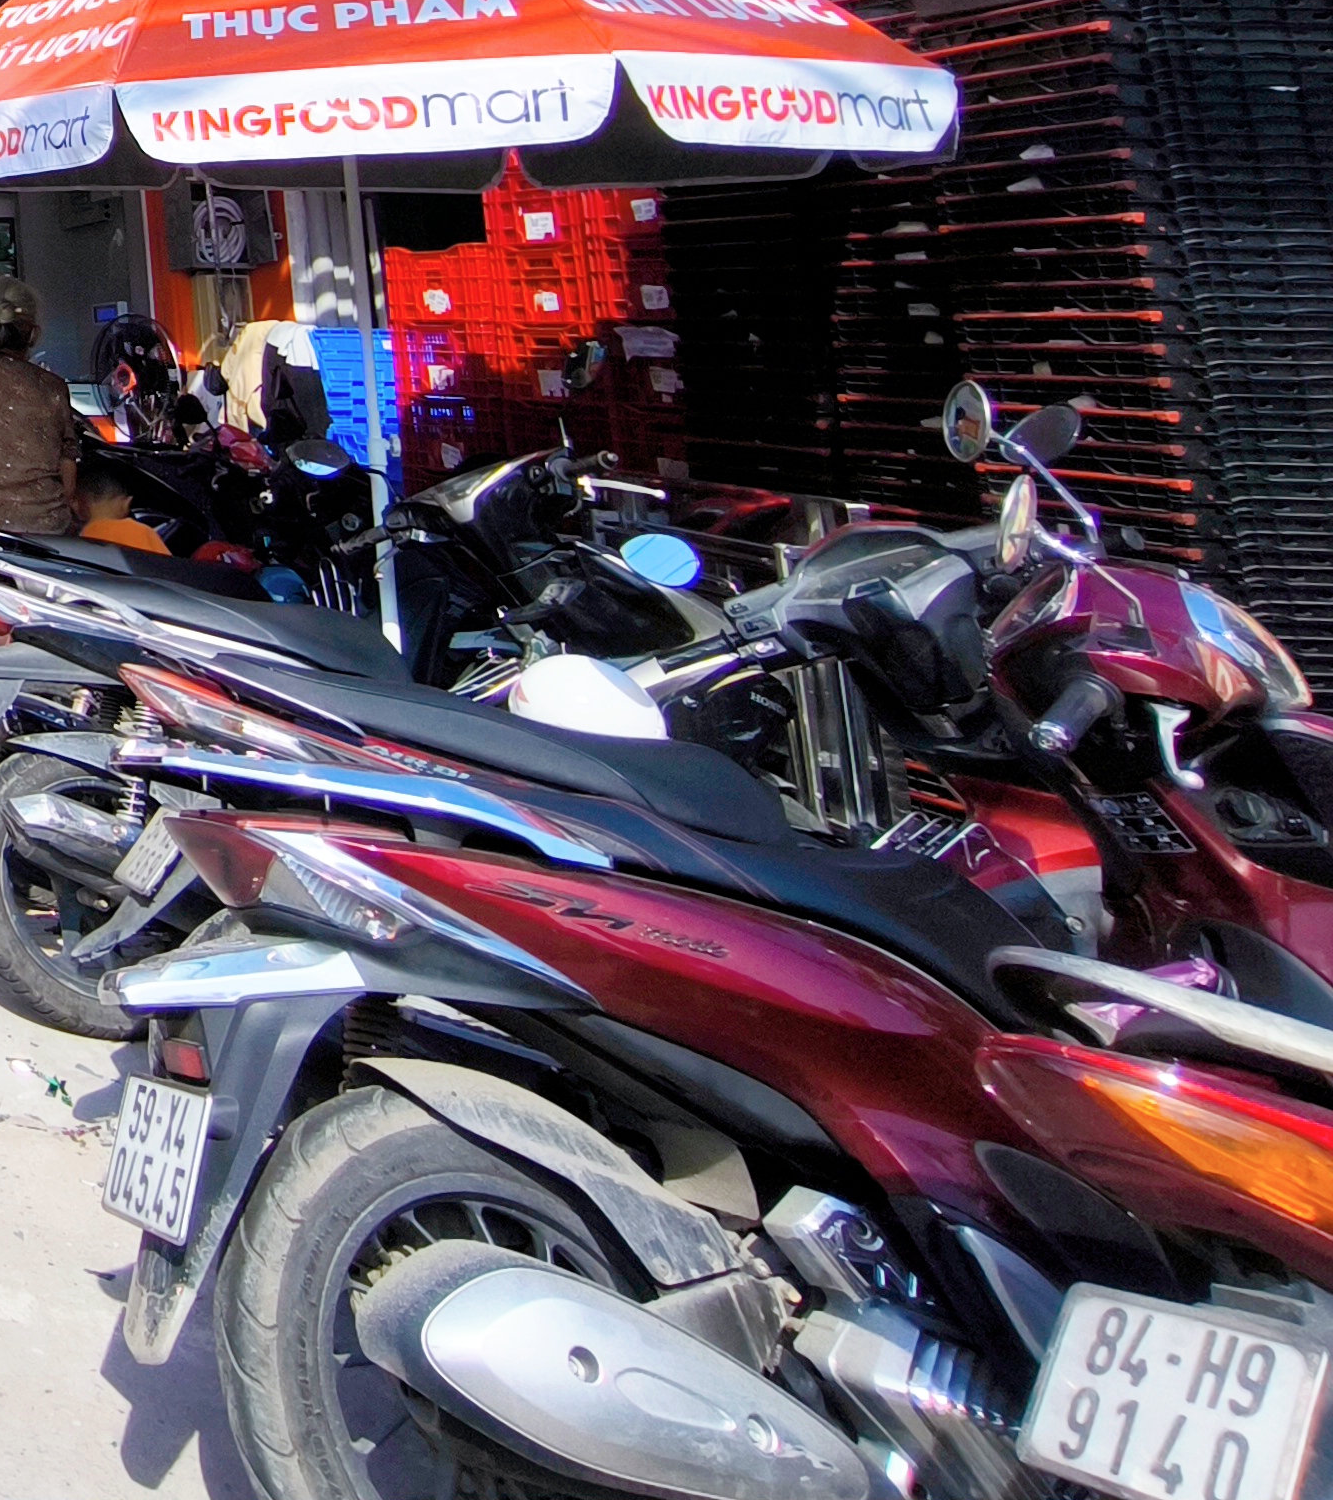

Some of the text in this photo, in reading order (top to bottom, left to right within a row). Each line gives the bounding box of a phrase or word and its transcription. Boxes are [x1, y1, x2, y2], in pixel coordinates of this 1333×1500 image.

[18, 17, 137, 65] LƯỢNG
[182, 4, 319, 41] THỰC
[126, 1083, 190, 1160] 59-X4
[107, 1153, 189, 1242] 045.45
[1085, 1305, 1278, 1417] 84-H9
[1058, 1385, 1250, 1500] 9140
